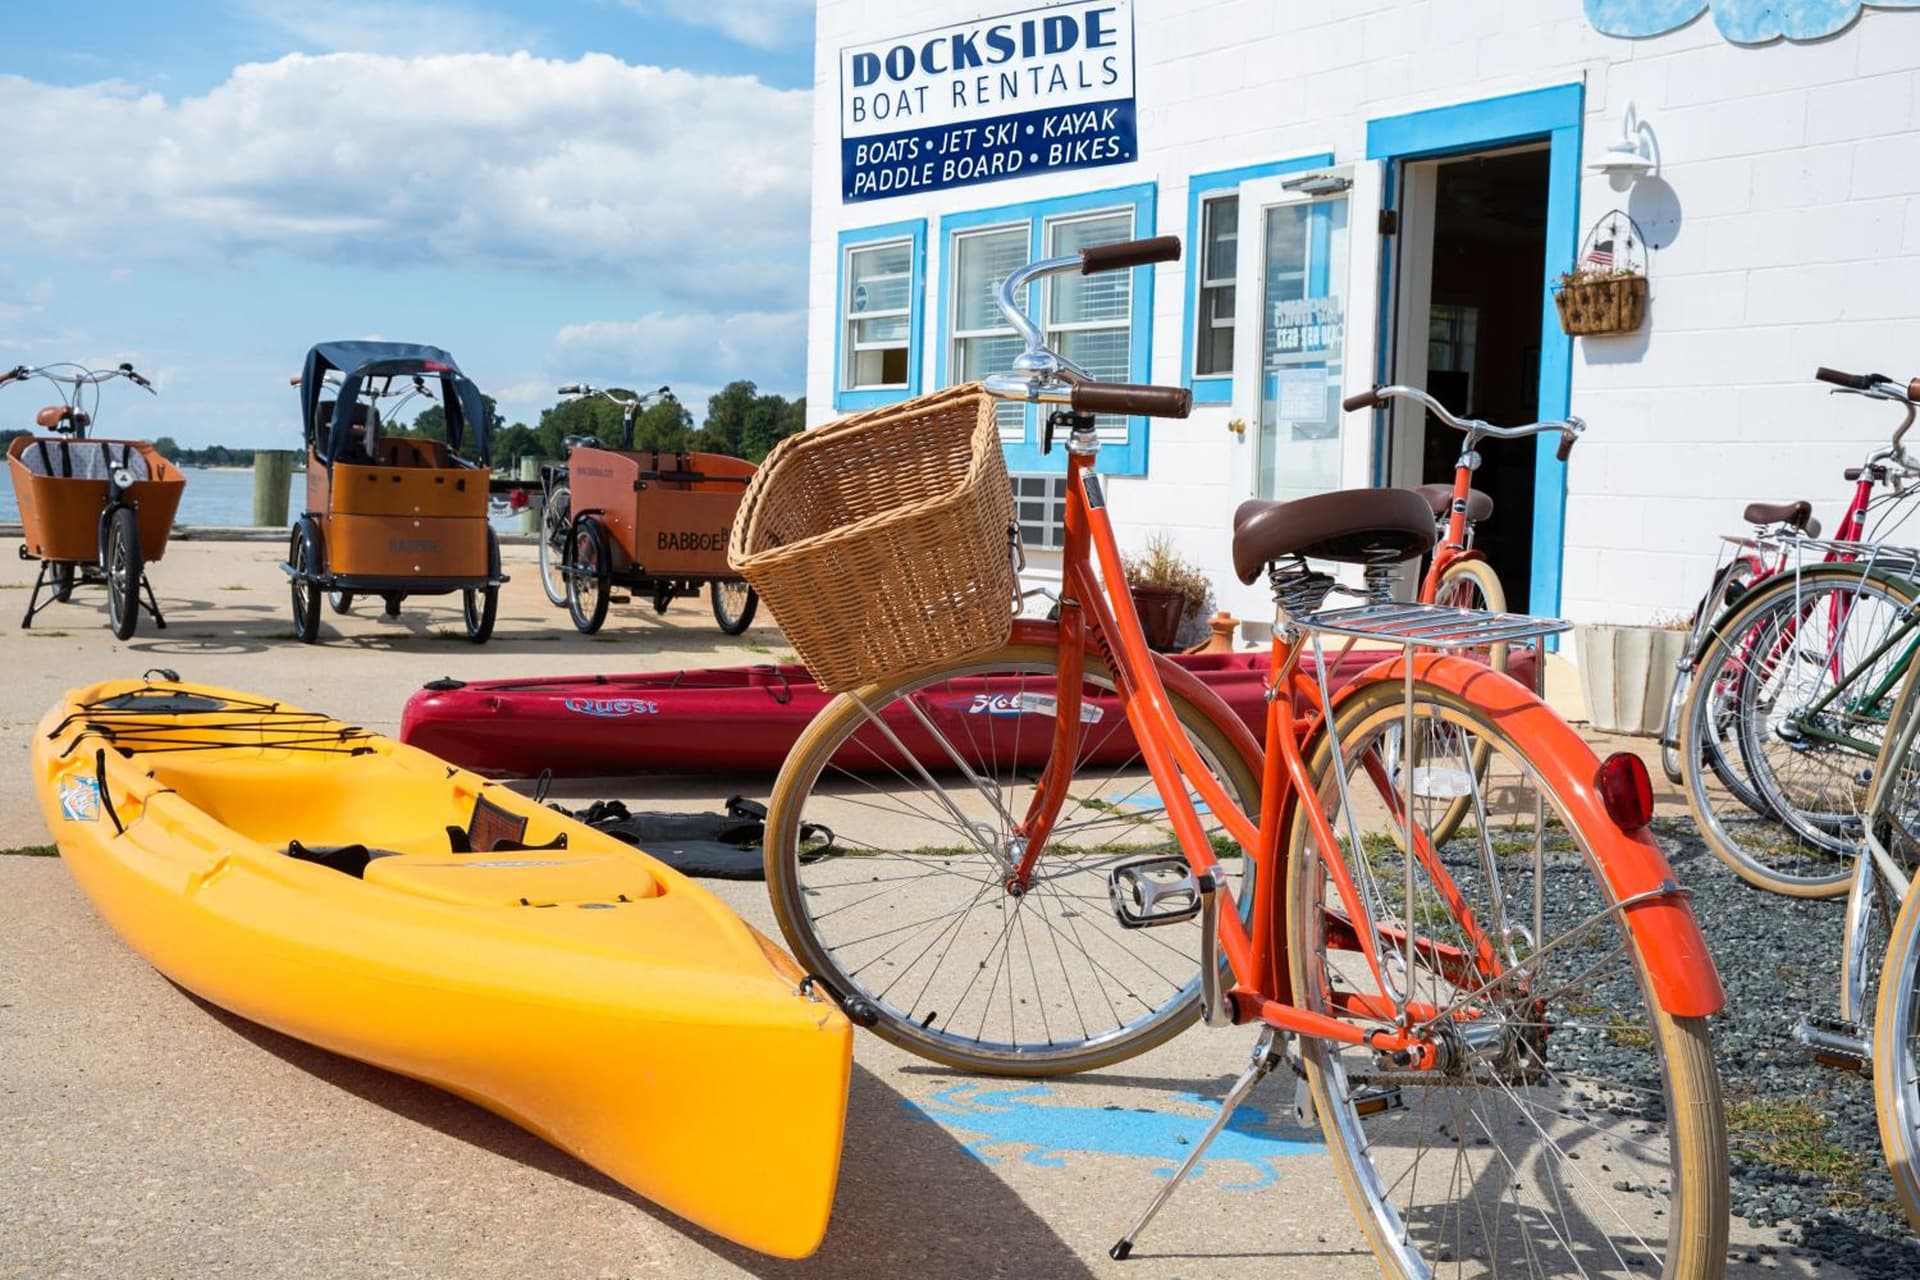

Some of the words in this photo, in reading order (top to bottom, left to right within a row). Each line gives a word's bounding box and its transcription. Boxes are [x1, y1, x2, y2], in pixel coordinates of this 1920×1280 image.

[852, 7, 1117, 88] DOCKSIDE
[853, 86, 929, 123] BOAT
[953, 56, 1118, 108] RENTALS
[854, 161, 934, 195] PADDLE
[942, 149, 1023, 182] BOARD
[1048, 136, 1121, 166] BIKES
[855, 137, 920, 166] BOATS
[938, 128, 976, 155] JET
[982, 121, 1018, 148] SKI
[1042, 107, 1118, 139] KAYAK
[565, 697, 659, 717] Quest
